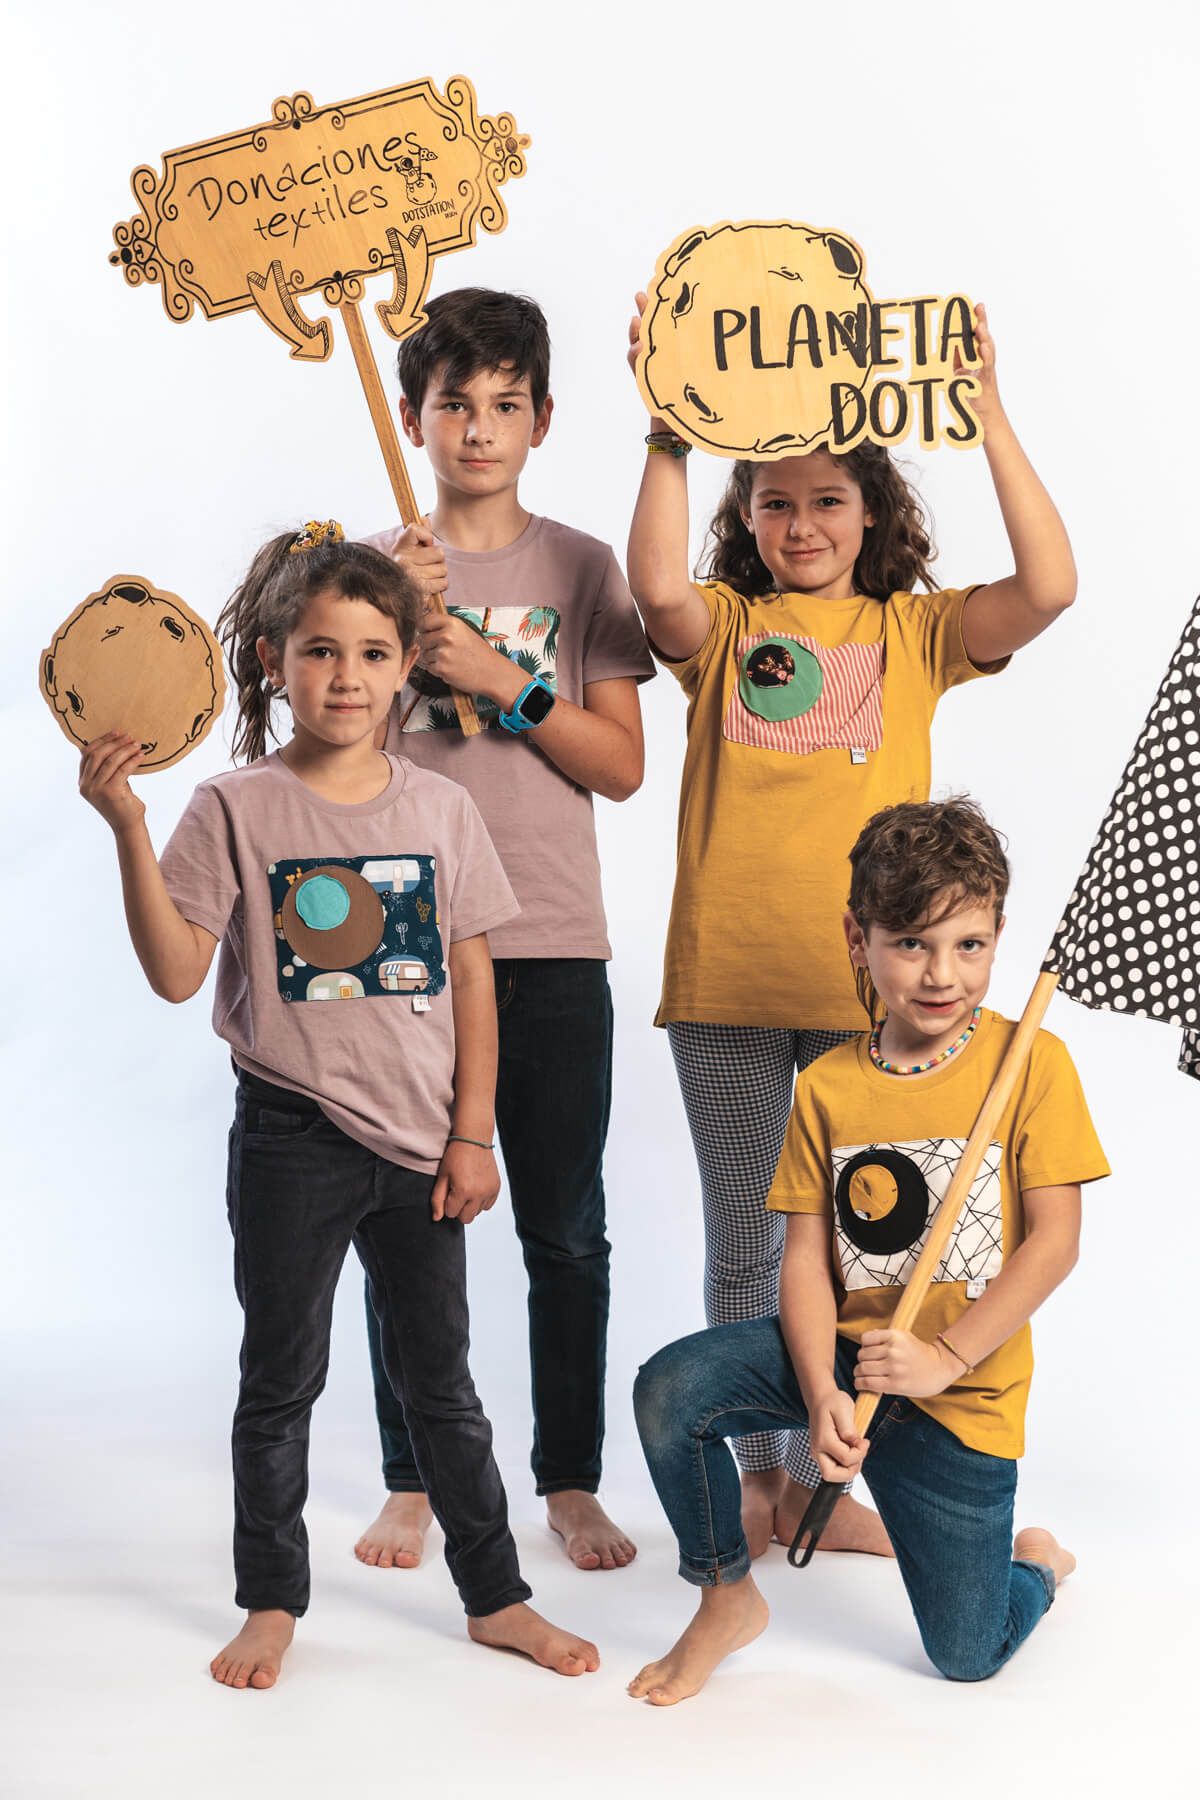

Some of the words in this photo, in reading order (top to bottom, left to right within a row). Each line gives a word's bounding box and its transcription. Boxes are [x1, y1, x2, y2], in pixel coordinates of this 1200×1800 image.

[188, 131, 422, 221] Donaciones
[253, 184, 390, 248] textiles
[402, 198, 456, 223] DOTSTATION
[713, 297, 976, 371] PLANETA
[830, 378, 977, 445] DOTS
